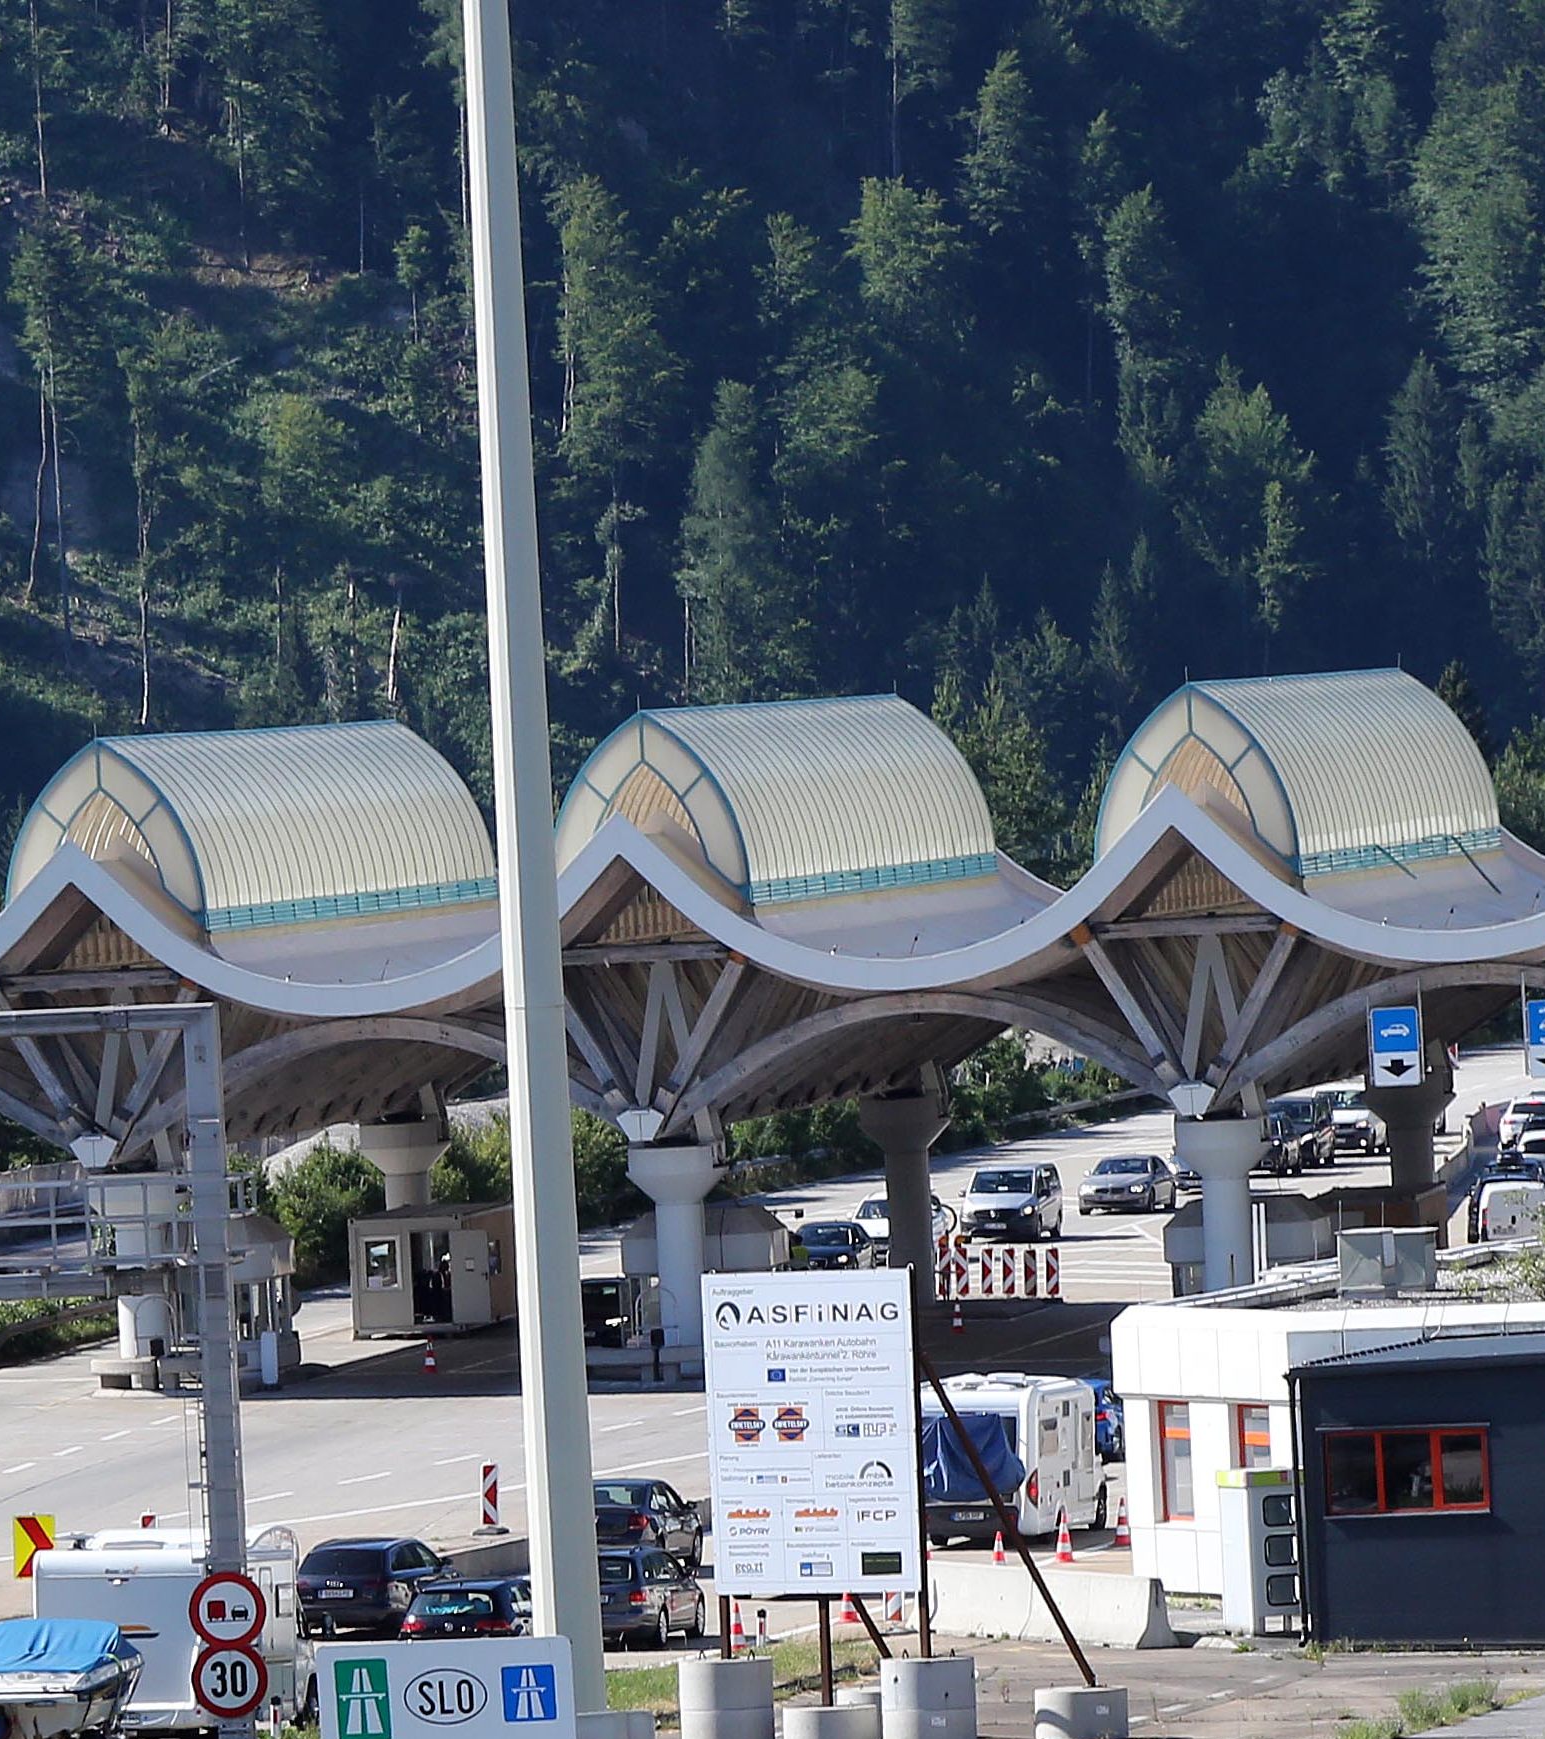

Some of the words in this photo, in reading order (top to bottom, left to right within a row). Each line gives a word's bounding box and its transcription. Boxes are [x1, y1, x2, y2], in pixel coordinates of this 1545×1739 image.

[711, 1288, 754, 1297] Auftraggeber
[714, 1340, 758, 1348] Bauvorhaben
[765, 1340, 781, 1349] A11
[783, 1338, 835, 1348] Karawanken
[836, 1336, 877, 1347] Autobahn
[766, 1350, 841, 1361] Karawankentunnel
[852, 1349, 877, 1360] Röhre
[210, 1660, 249, 1699] 30
[417, 1677, 476, 1716] SLO
